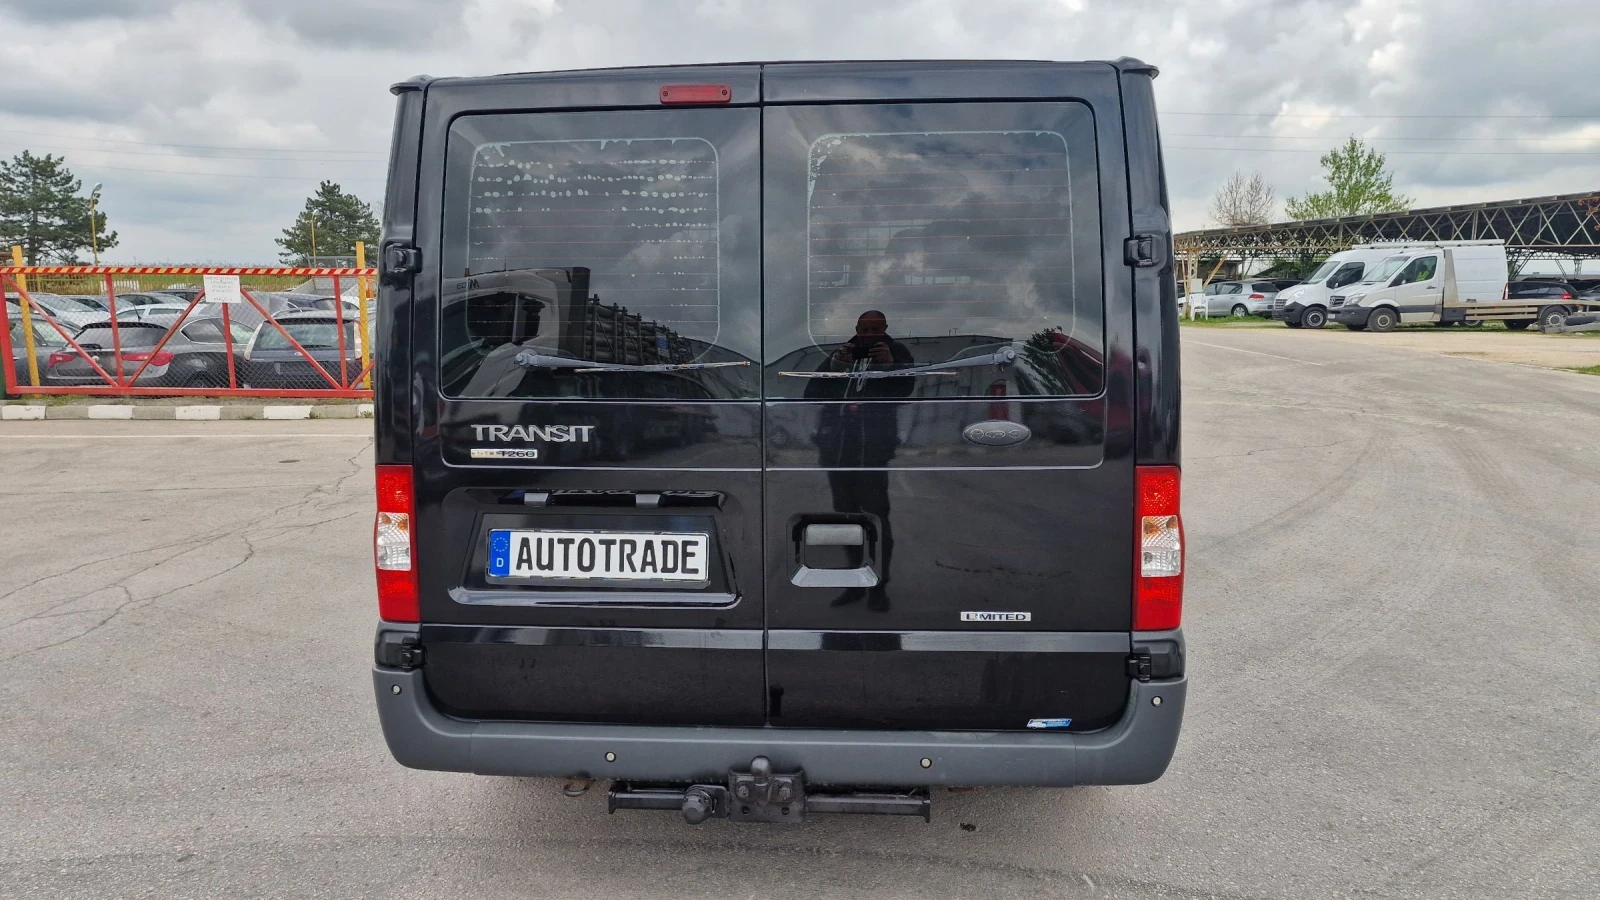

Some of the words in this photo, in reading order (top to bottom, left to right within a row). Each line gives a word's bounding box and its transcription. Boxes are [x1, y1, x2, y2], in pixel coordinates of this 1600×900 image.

[470, 424, 595, 442] TRANSIT
[496, 557, 504, 568] D
[515, 537, 700, 575] AUTOTRADE
